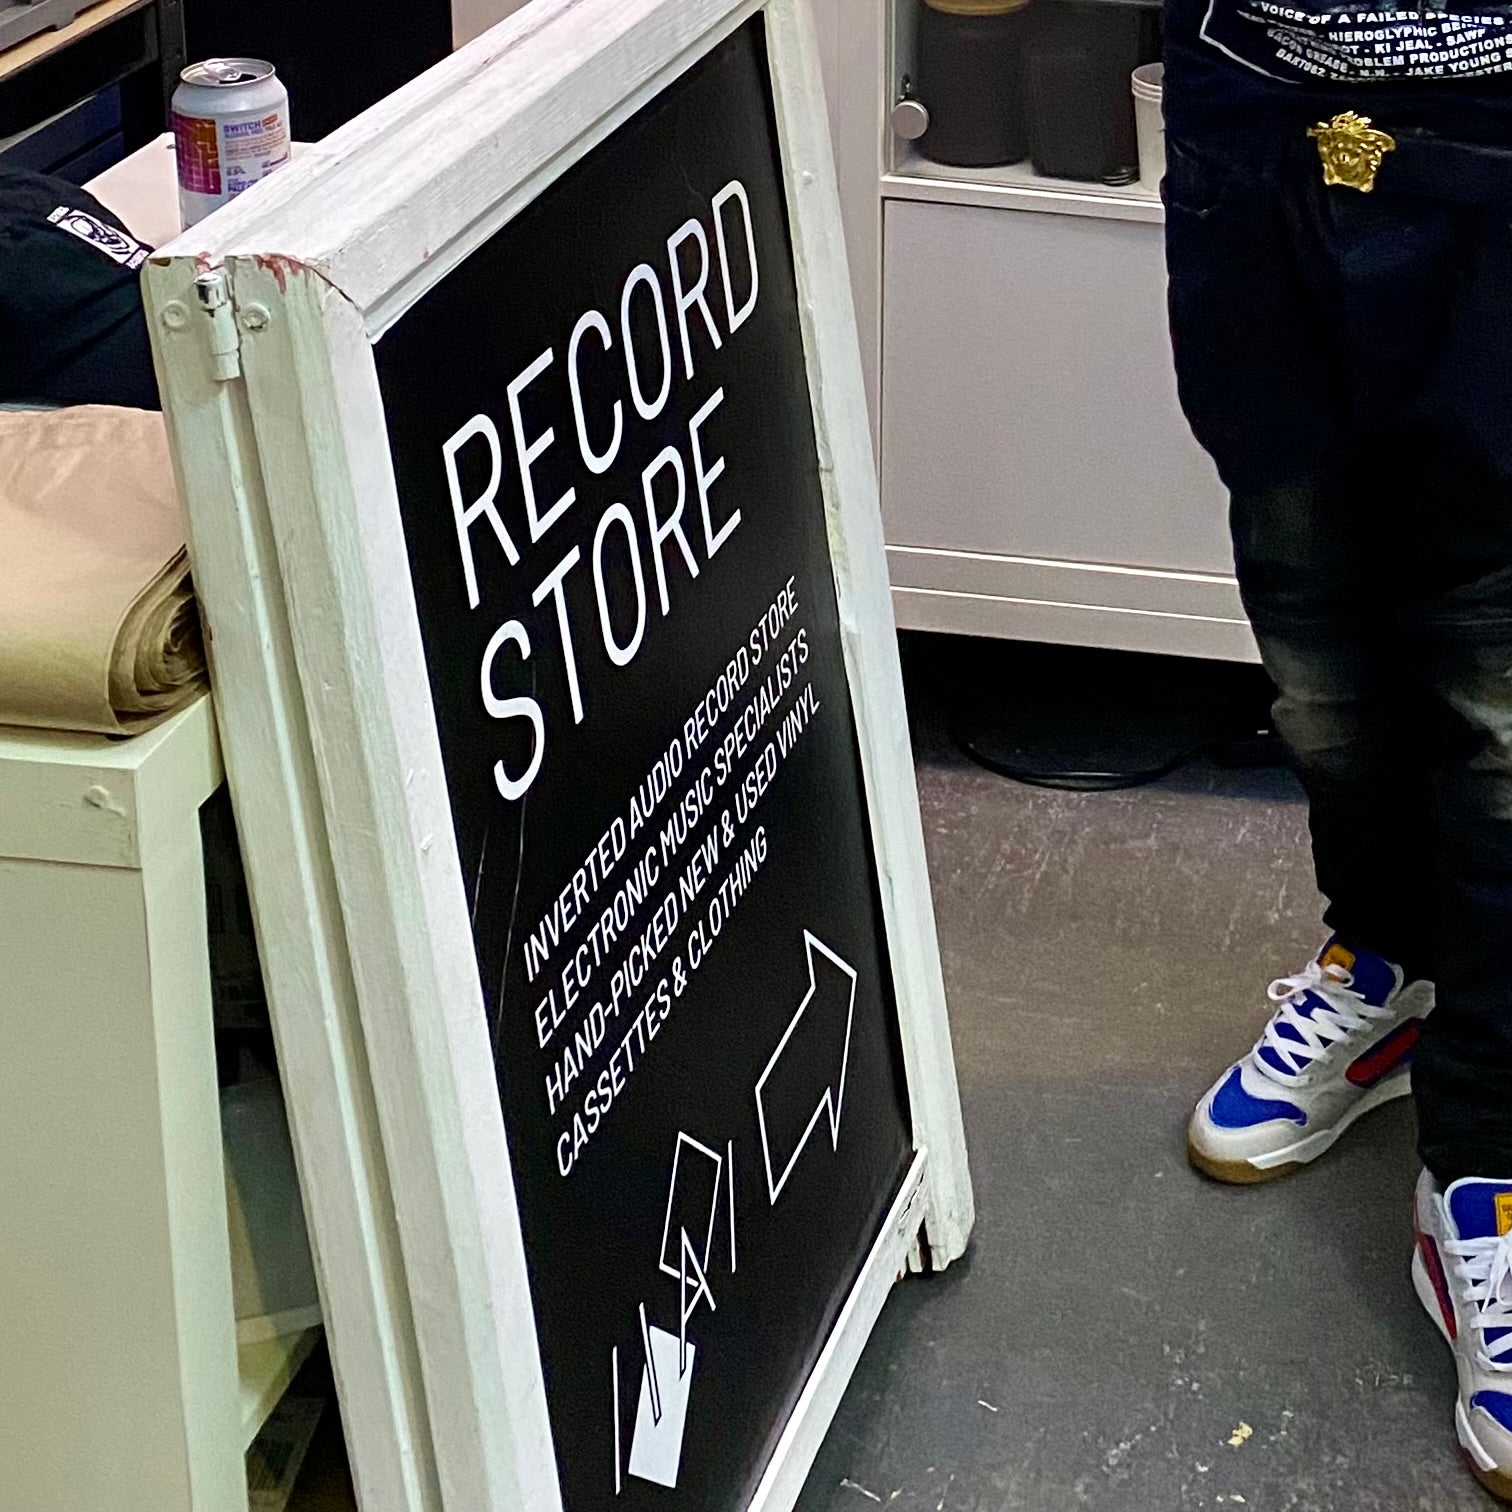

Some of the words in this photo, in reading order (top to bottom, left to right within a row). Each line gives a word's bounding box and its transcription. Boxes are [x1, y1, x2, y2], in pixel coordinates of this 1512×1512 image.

[1260, 1, 1306, 22] VOICE
[1308, 14, 1332, 25] OF
[1338, 13, 1351, 23] A
[1357, 11, 1420, 23] FAILED
[1328, 26, 1438, 43] HIEROGLYPHIC
[1441, 21, 1484, 34] BEI
[1396, 39, 1434, 52] JEAL
[1405, 65, 1444, 76] JAKE
[1447, 52, 1502, 73] YOUNG
[442, 180, 758, 610] RECORD
[481, 386, 741, 801] STORE
[523, 817, 627, 983] INVERTED
[630, 738, 683, 840] AUDIO
[684, 646, 749, 760] RECORD
[750, 575, 799, 665] STORE
[534, 846, 659, 1049] ELECTRONIC
[660, 766, 713, 867] MUSIC
[714, 627, 809, 786] SPECIALISTS
[545, 892, 678, 1116] HAND-PICKED
[678, 824, 719, 913] NEW
[720, 809, 735, 848] &
[735, 742, 777, 824] USED
[776, 682, 820, 759] VINYL
[556, 982, 671, 1177] CASSETTES
[671, 956, 688, 998] &
[688, 825, 768, 970] CLOTHING
